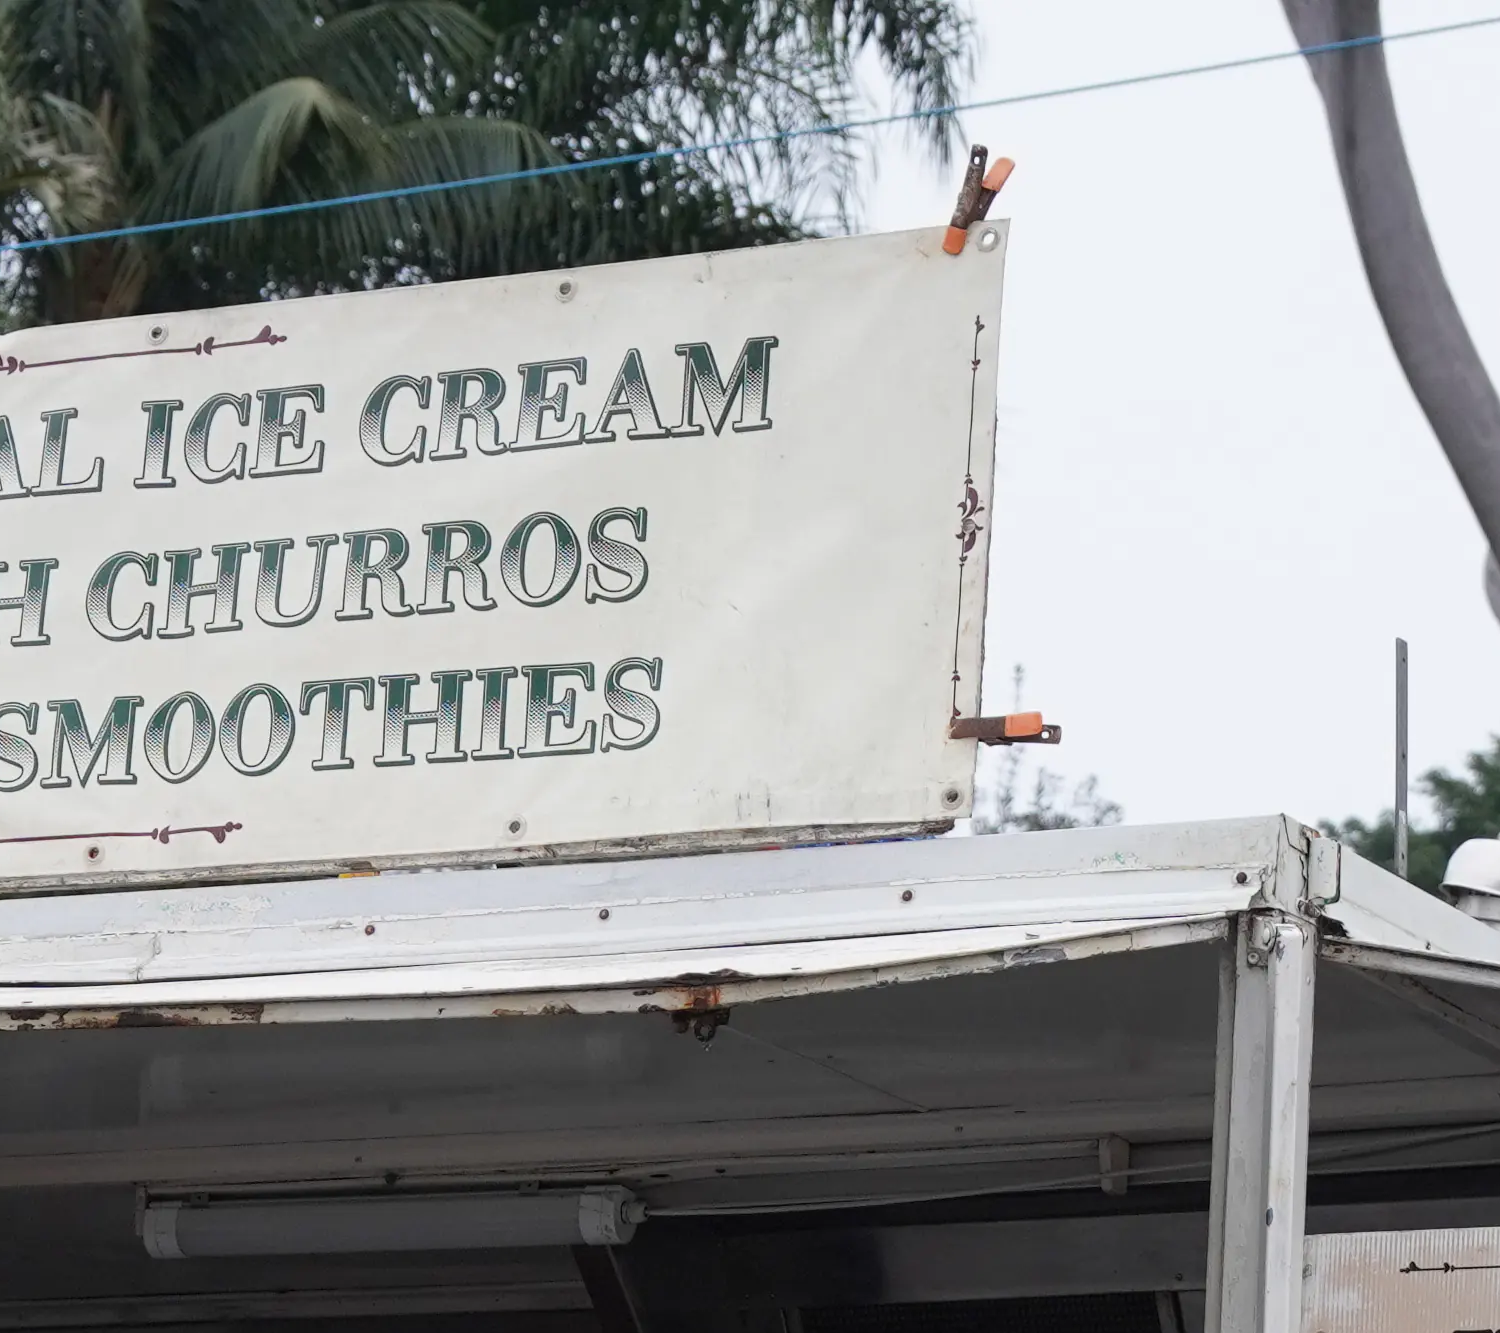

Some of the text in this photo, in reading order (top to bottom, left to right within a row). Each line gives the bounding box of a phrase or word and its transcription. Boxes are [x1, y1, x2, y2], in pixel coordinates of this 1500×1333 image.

[136, 382, 330, 490] ICE
[358, 334, 780, 466] CREAM
[86, 504, 651, 642] CHURROS
